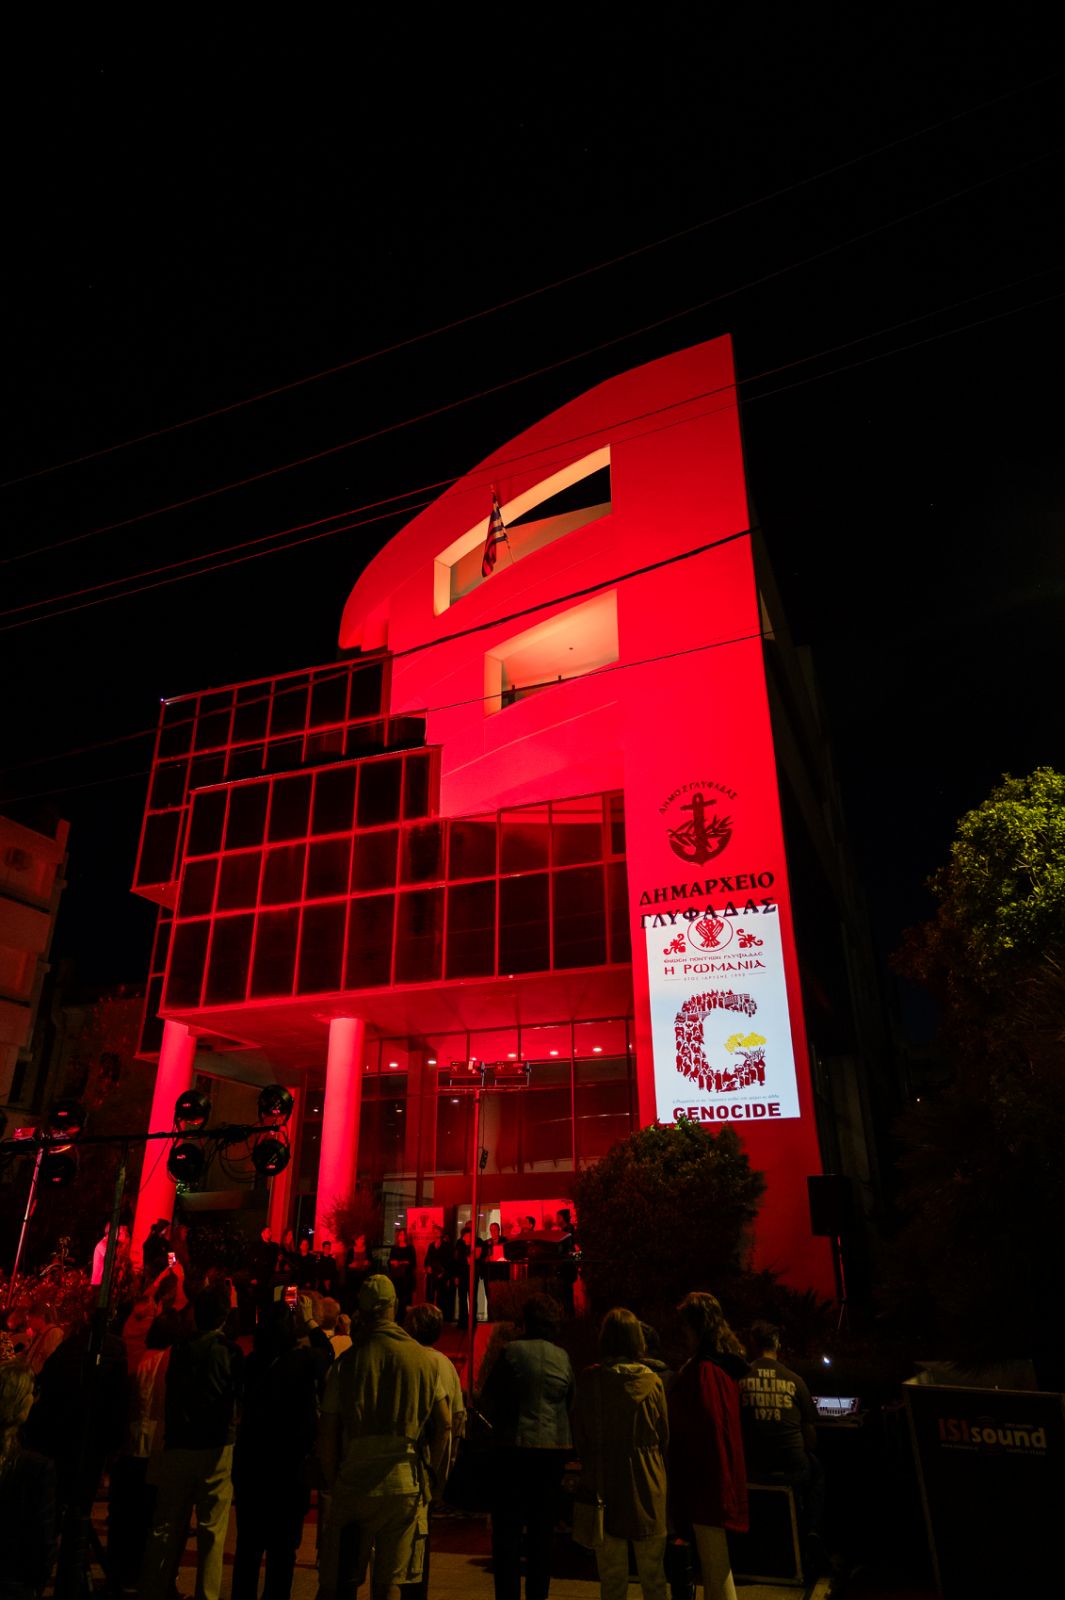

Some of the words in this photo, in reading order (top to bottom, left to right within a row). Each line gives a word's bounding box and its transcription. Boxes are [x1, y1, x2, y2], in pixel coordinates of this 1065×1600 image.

[659, 785, 688, 814] ΔΗΜΟΣ
[690, 781, 738, 800] ΓΛΥΦΑΔΑΣ
[639, 872, 775, 906] ΔΗΜΑΡΧΕΙΟ
[640, 897, 777, 929] ΓΛΥΦΑΔΑΣ
[673, 1102, 781, 1121] GENOCIDE
[757, 1368, 776, 1378] THE
[741, 1392, 793, 1409] STONES
[754, 1408, 782, 1422] 1978
